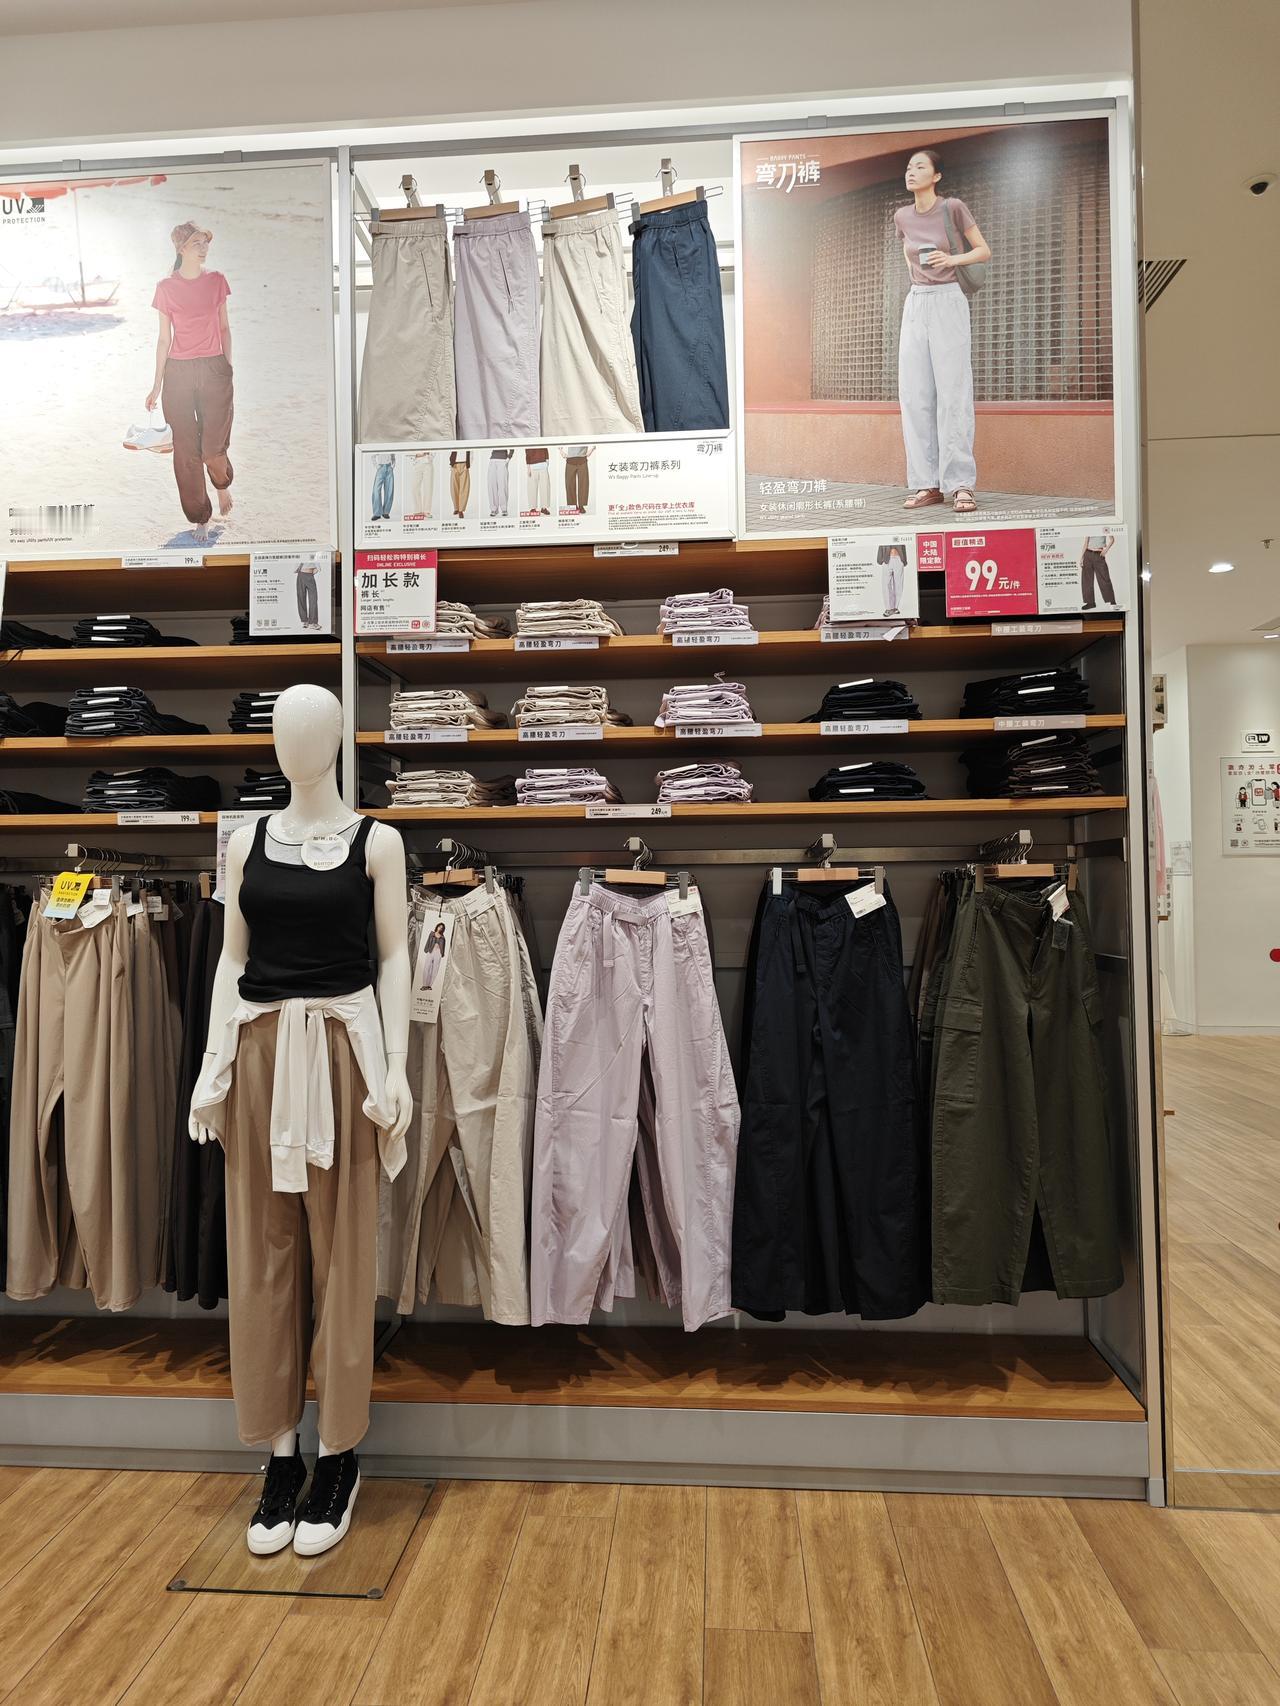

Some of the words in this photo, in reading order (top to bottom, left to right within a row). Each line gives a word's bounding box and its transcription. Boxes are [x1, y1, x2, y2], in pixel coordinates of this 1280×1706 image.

[755, 160, 820, 193] 弯刀裤
[2, 198, 25, 215] UV
[2, 216, 46, 225] PROTECTION
[608, 460, 682, 473] 女装弯刀裤系列
[759, 479, 827, 495] 轻盈弯刀裤
[759, 498, 867, 512] 女装休闲廓形长裤(系腰带)
[922, 540, 938, 549] 中国
[953, 538, 984, 546] 超值精选
[658, 544, 669, 553] 249
[923, 549, 938, 557] 大陆
[184, 556, 194, 565] 199
[919, 557, 942, 565] 限定款
[361, 571, 420, 589] 加长款
[651, 807, 662, 816] 249
[180, 814, 190, 823] 199
[60, 881, 72, 890] UV
